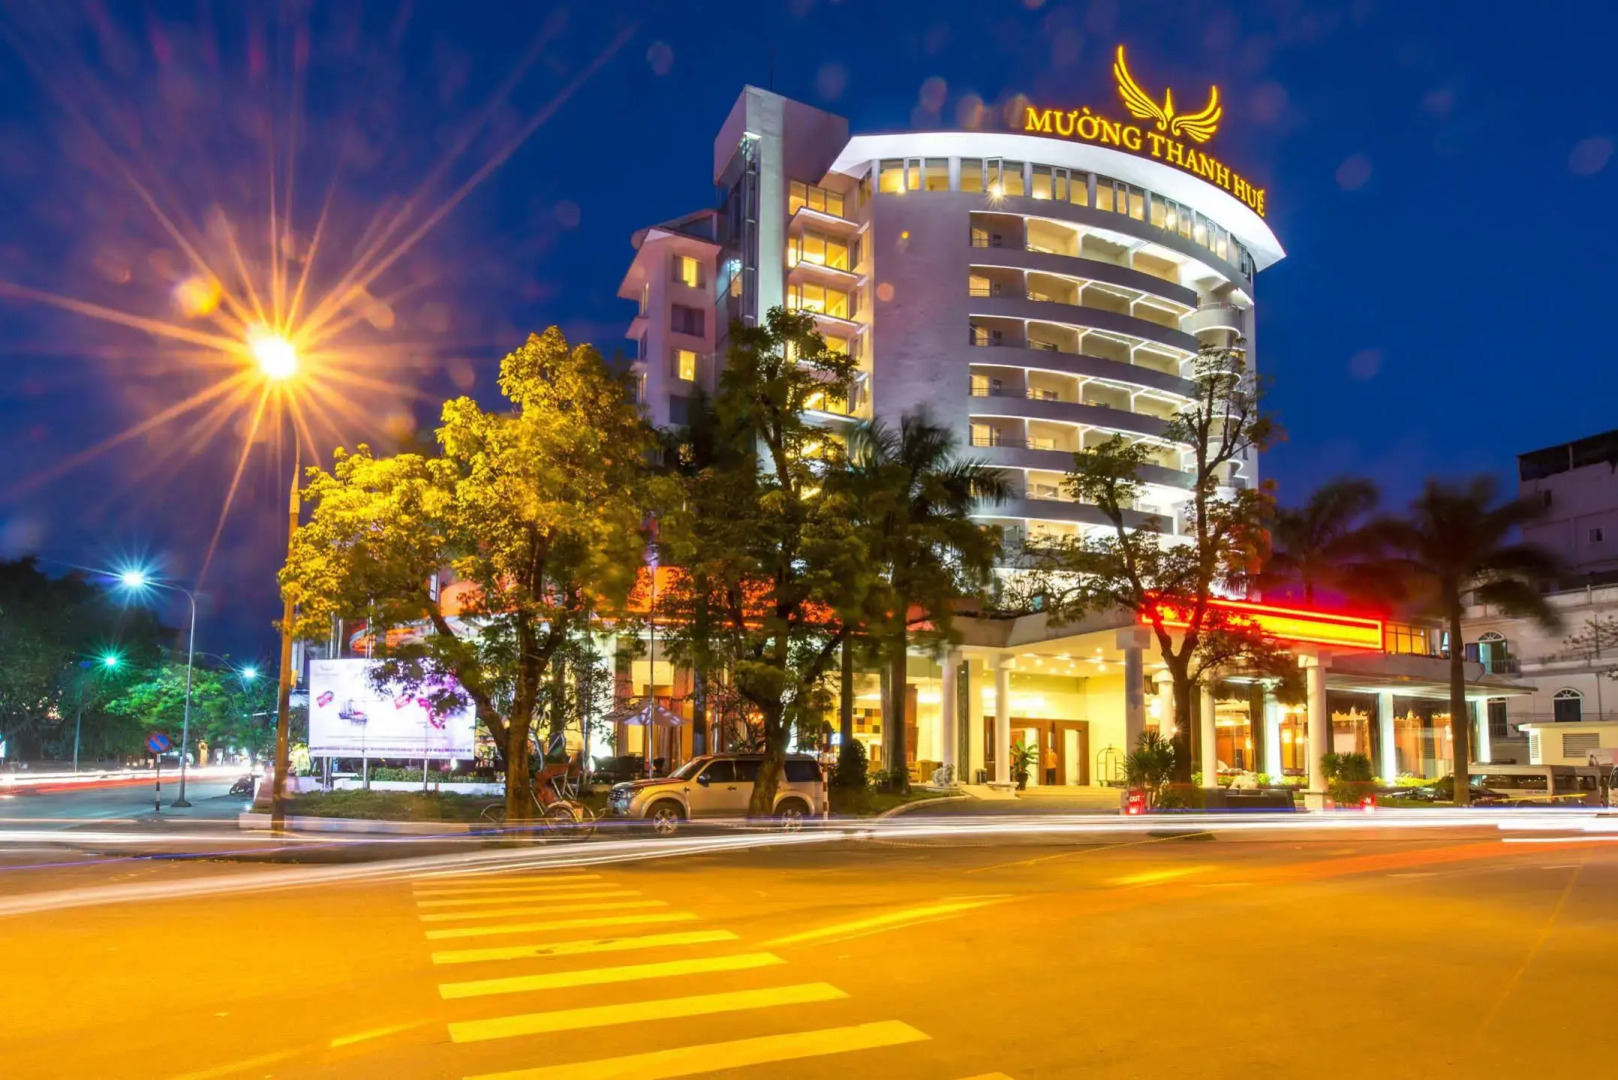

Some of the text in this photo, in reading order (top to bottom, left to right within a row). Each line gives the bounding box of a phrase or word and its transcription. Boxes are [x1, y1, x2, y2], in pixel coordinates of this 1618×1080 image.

[1025, 107, 1266, 218] MƯỜNG THANH HUẾ
